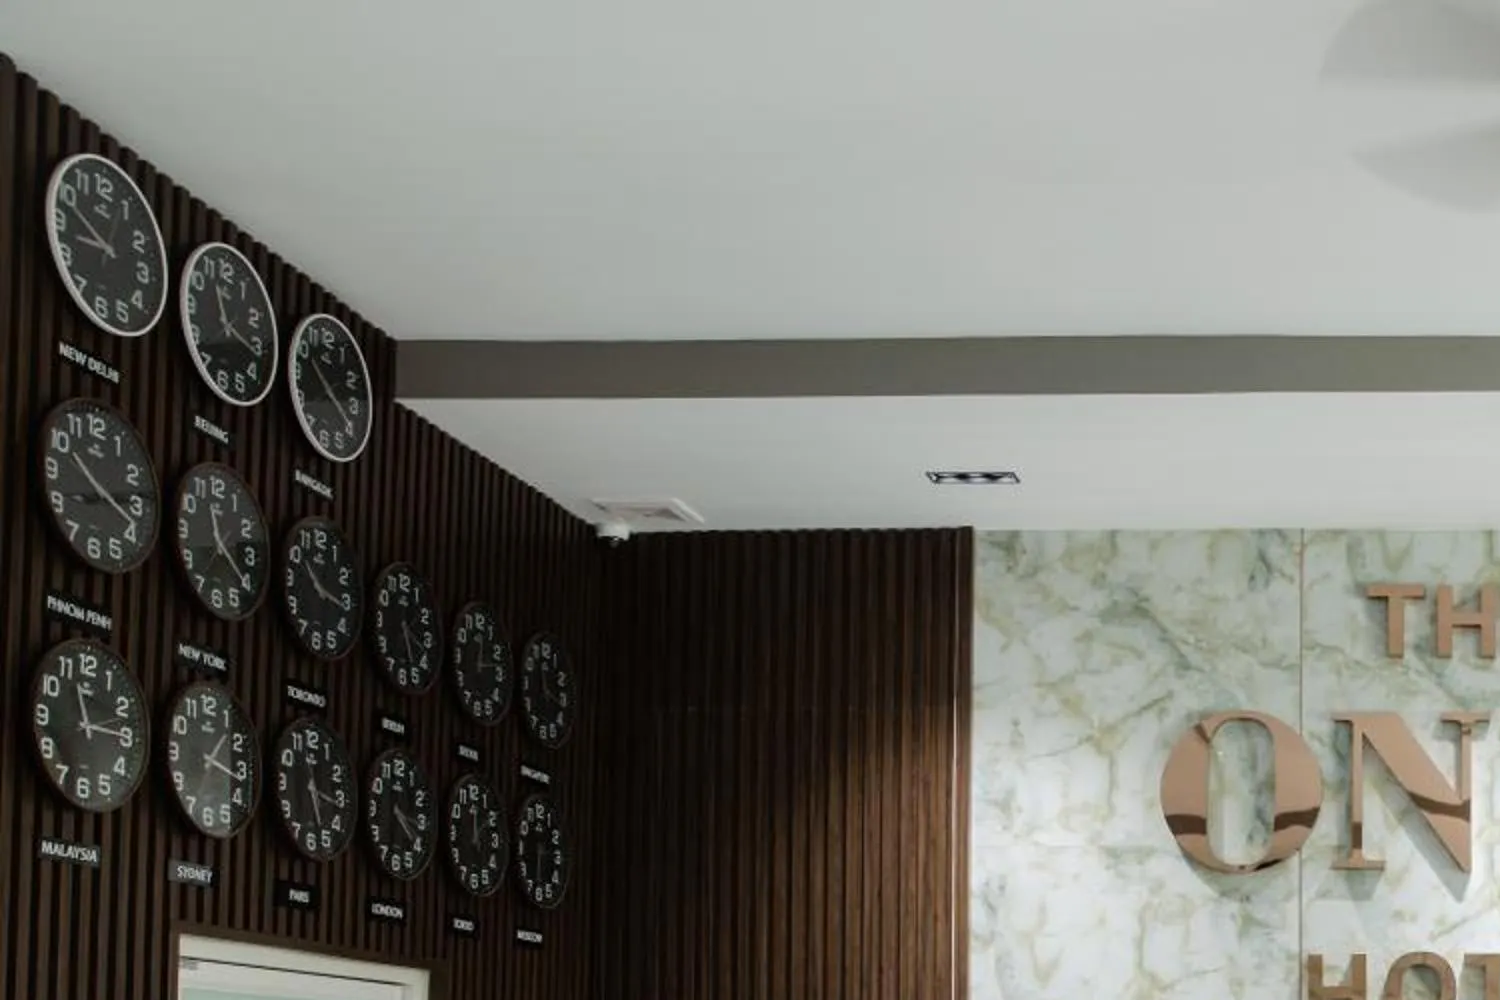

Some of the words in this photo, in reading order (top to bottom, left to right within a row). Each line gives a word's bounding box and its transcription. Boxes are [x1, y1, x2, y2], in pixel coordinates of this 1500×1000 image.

[74, 168, 90, 196] 11
[94, 172, 113, 203] 12
[121, 199, 130, 221] 1
[132, 229, 146, 254] 2
[136, 260, 149, 285] 3
[203, 255, 215, 280] 11
[219, 257, 235, 285] 12
[74, 273, 88, 295] 7
[239, 280, 246, 301] 1
[115, 298, 129, 323] 5
[130, 289, 144, 310] 4
[248, 306, 260, 330] 2
[59, 340, 87, 366] NEW
[251, 335, 263, 357] 3
[200, 350, 212, 368] 7
[217, 369, 229, 391] 6
[234, 371, 246, 394] 5
[246, 361, 257, 381] 4
[66, 412, 82, 440] 11
[86, 412, 107, 441] 12
[52, 427, 71, 454] 10
[113, 434, 122, 458] 1
[126, 463, 140, 487] 2
[193, 476, 206, 500] 11
[210, 475, 226, 500] 12
[129, 494, 144, 518] 3
[182, 493, 197, 515] 10
[231, 492, 238, 513] 1
[65, 519, 80, 543] 7
[124, 520, 137, 543] 4
[240, 517, 253, 540] 2
[300, 528, 311, 551] 11
[313, 527, 328, 551] 12
[87, 536, 101, 559] 6
[109, 537, 123, 560] 5
[244, 545, 256, 568] 3
[331, 543, 338, 565] 1
[193, 573, 206, 593] 7
[241, 572, 251, 593] 4
[338, 566, 350, 587] 2
[211, 588, 223, 609] 6
[228, 586, 240, 608] 5
[340, 592, 351, 612] 3
[85, 609, 112, 631] PENH
[298, 618, 309, 637] 7
[336, 616, 347, 634] 4
[311, 630, 322, 651] 6
[326, 629, 338, 650] 5
[58, 655, 73, 681] 11
[79, 652, 98, 678] 12
[178, 643, 200, 661] NEW
[203, 652, 226, 671] YORK
[43, 672, 60, 698] 10
[105, 669, 112, 692] 1
[36, 703, 49, 726] 9
[115, 695, 129, 719] 2
[185, 697, 198, 720] 11
[200, 693, 218, 718] 12
[172, 714, 188, 736] 10
[223, 709, 230, 729] 1
[40, 736, 54, 760] 8
[119, 726, 133, 749] 3
[231, 732, 244, 754] 2
[291, 731, 303, 753] 11
[304, 728, 320, 750] 12
[323, 742, 331, 762] 1
[55, 763, 70, 785] 7
[112, 755, 127, 778] 4
[236, 760, 248, 782] 3
[331, 763, 342, 784] 2
[76, 776, 91, 800] 6
[97, 773, 112, 797] 5
[231, 787, 243, 806] 4
[185, 794, 198, 815] 7
[334, 788, 346, 809] 3
[202, 805, 215, 828] 6
[219, 803, 231, 825] 5
[330, 813, 341, 832] 4
[291, 821, 302, 840] 7
[305, 831, 317, 852] 6
[321, 828, 332, 849] 5
[41, 839, 97, 863] MALAYSIA
[177, 864, 213, 883] SYDNEY
